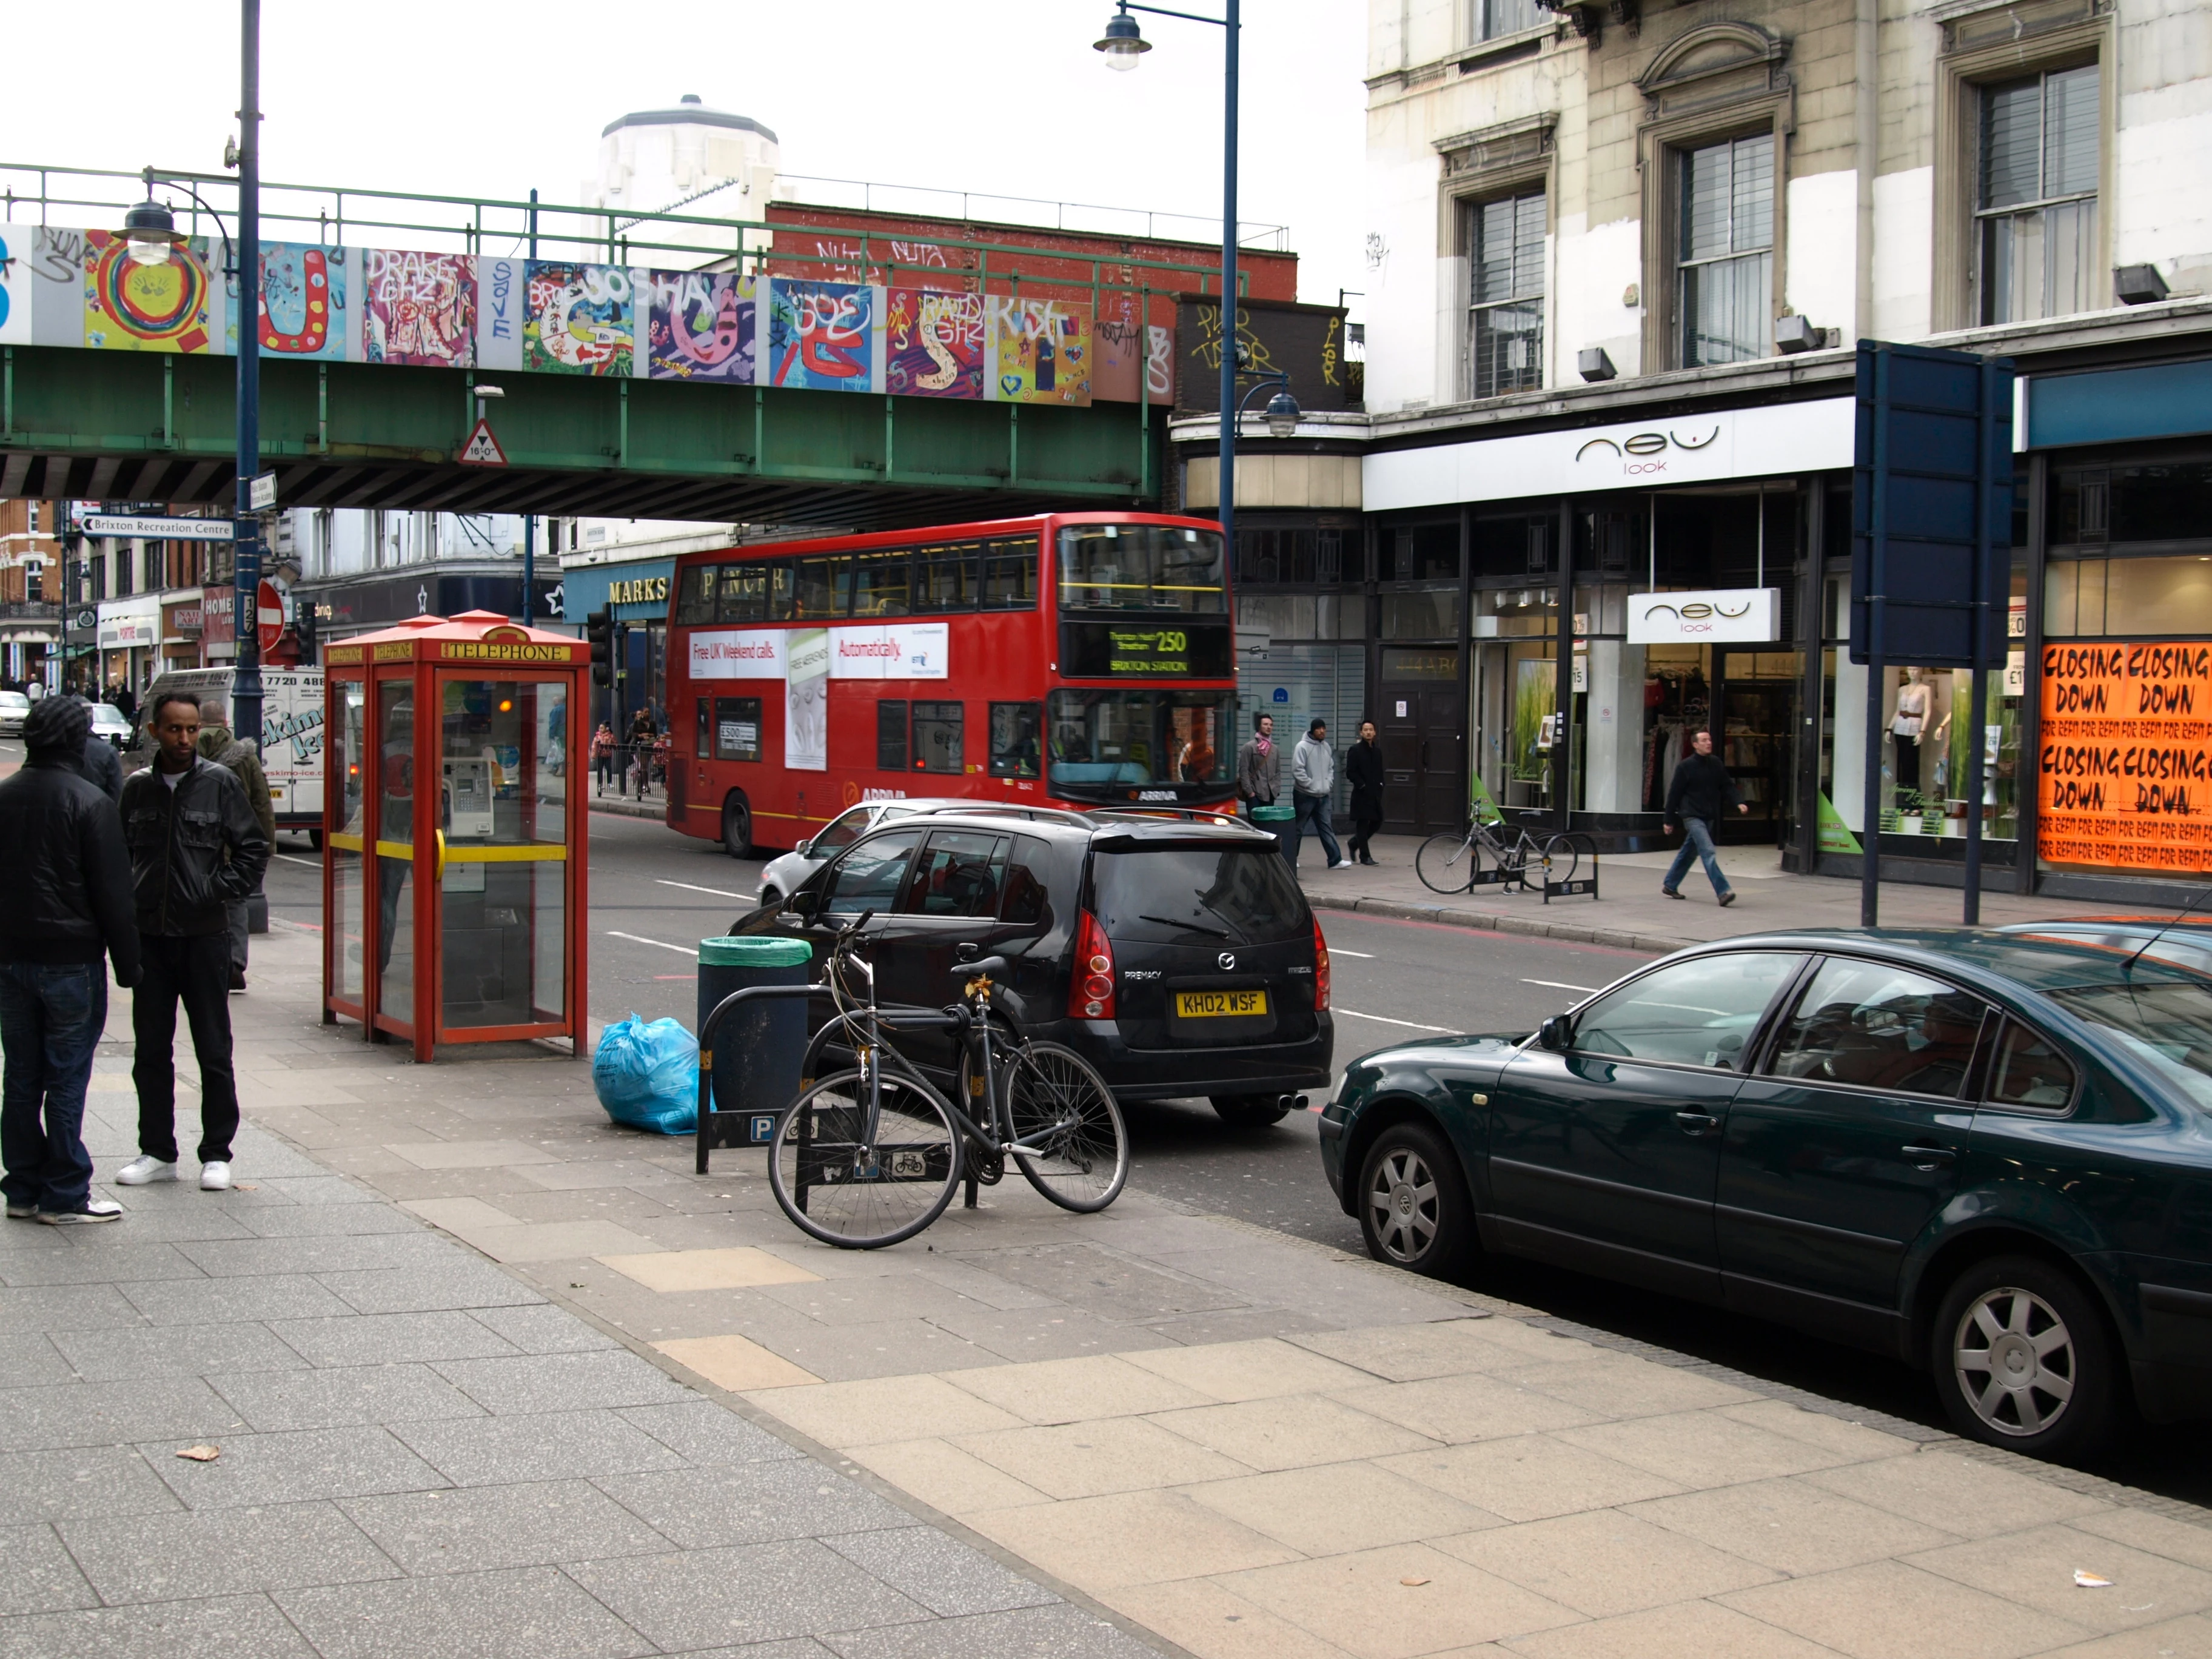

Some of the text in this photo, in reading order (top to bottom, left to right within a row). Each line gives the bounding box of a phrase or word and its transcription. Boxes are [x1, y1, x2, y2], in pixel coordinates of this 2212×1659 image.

[369, 250, 458, 284] DRAKE
[1624, 460, 1667, 475] look
[95, 520, 230, 534] Brixton Recreation Centre
[609, 577, 667, 604] MARKS
[179, 610, 201, 619] NAIL
[1680, 623, 1713, 632] look
[376, 643, 411, 659] TELEPHONE
[449, 643, 563, 661] TELEPHONE
[693, 640, 775, 660] Free UK Weekend calls.
[838, 637, 902, 662] Automatically.
[1156, 631, 1187, 652] 250
[330, 647, 361, 662] TELEPHONE
[2044, 648, 2123, 680] CLOSING
[2128, 647, 2210, 680] CLOSING
[1110, 660, 1187, 672] BRIXTON STATION
[267, 677, 297, 686] 7720
[2056, 683, 2110, 714] DOWN
[2139, 683, 2196, 715] DOWN
[2042, 720, 2056, 737] FOR
[2059, 720, 2079, 737] REFIT
[2082, 720, 2096, 738] FOR
[2099, 720, 2120, 739] REFIT
[2122, 720, 2137, 738] FOR
[2140, 720, 2162, 739] REFIT
[2164, 722, 2179, 739] FOR
[2182, 722, 2205, 740] REFIT
[2042, 745, 2120, 779] CLOSING
[2124, 746, 2207, 783] CLOSING
[1138, 791, 1178, 802] ARRIVA
[2054, 780, 2107, 812] DOWN
[2137, 782, 2192, 817] DOWN
[2039, 816, 2053, 833] FOR
[2056, 816, 2076, 834] REFIT
[2078, 818, 2093, 835] FOR
[2095, 819, 2117, 836] REFIT
[2119, 820, 2134, 837] FOR
[2137, 821, 2159, 839] REFIT
[2161, 822, 2177, 839] FOR
[2179, 823, 2202, 842] REFIT
[2039, 840, 2054, 857] FOR
[2056, 840, 2077, 859] REFIT
[2078, 842, 2093, 859] FOR
[2096, 843, 2117, 861] REFIT
[2119, 844, 2134, 862] FOR
[2137, 845, 2158, 863] REFIT
[2160, 847, 2176, 865] FOR
[2179, 848, 2201, 866] REFIT
[1124, 971, 1162, 980] PREMACY
[1183, 993, 1258, 1014] KH02 WSF
[756, 1119, 771, 1140] P
